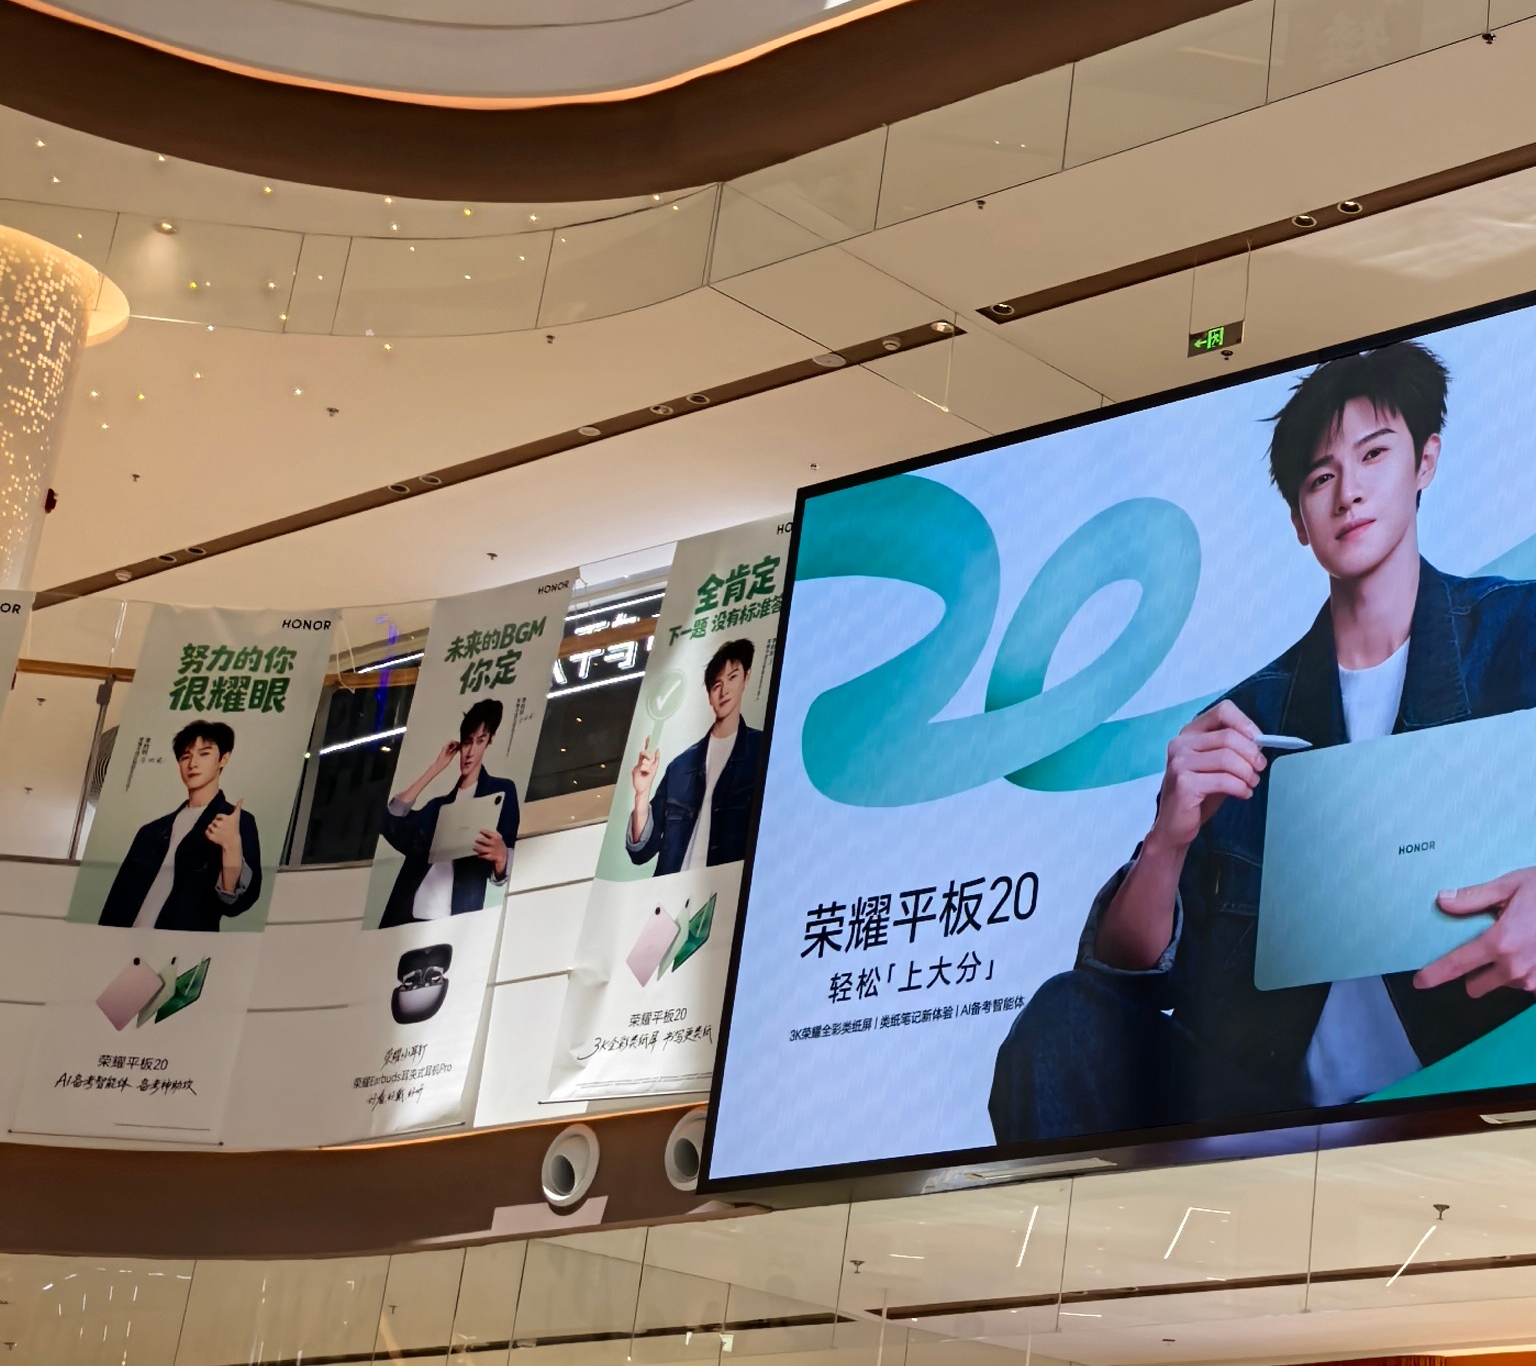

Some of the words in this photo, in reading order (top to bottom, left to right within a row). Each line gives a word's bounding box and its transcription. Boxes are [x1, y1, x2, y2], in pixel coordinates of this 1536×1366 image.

[538, 580, 569, 595] HONOR
[694, 555, 781, 615] 全肯定
[282, 619, 331, 630] HONOR
[444, 616, 547, 662] 未来的BGM
[669, 617, 709, 646] 下一题
[178, 643, 297, 674] 努力的你
[460, 649, 522, 694] 你定
[169, 676, 290, 713] 很耀眼
[1397, 841, 1436, 854] HONOR
[800, 871, 1039, 959] 荣耀平板20
[828, 950, 994, 1004] 轻松「上大分」
[629, 1008, 688, 1027] 荣耀平板20
[879, 1007, 954, 1029] 类纸笔记新体验
[961, 995, 1025, 1016] AI备考智能体
[98, 1055, 169, 1070] 荣耀平板20
